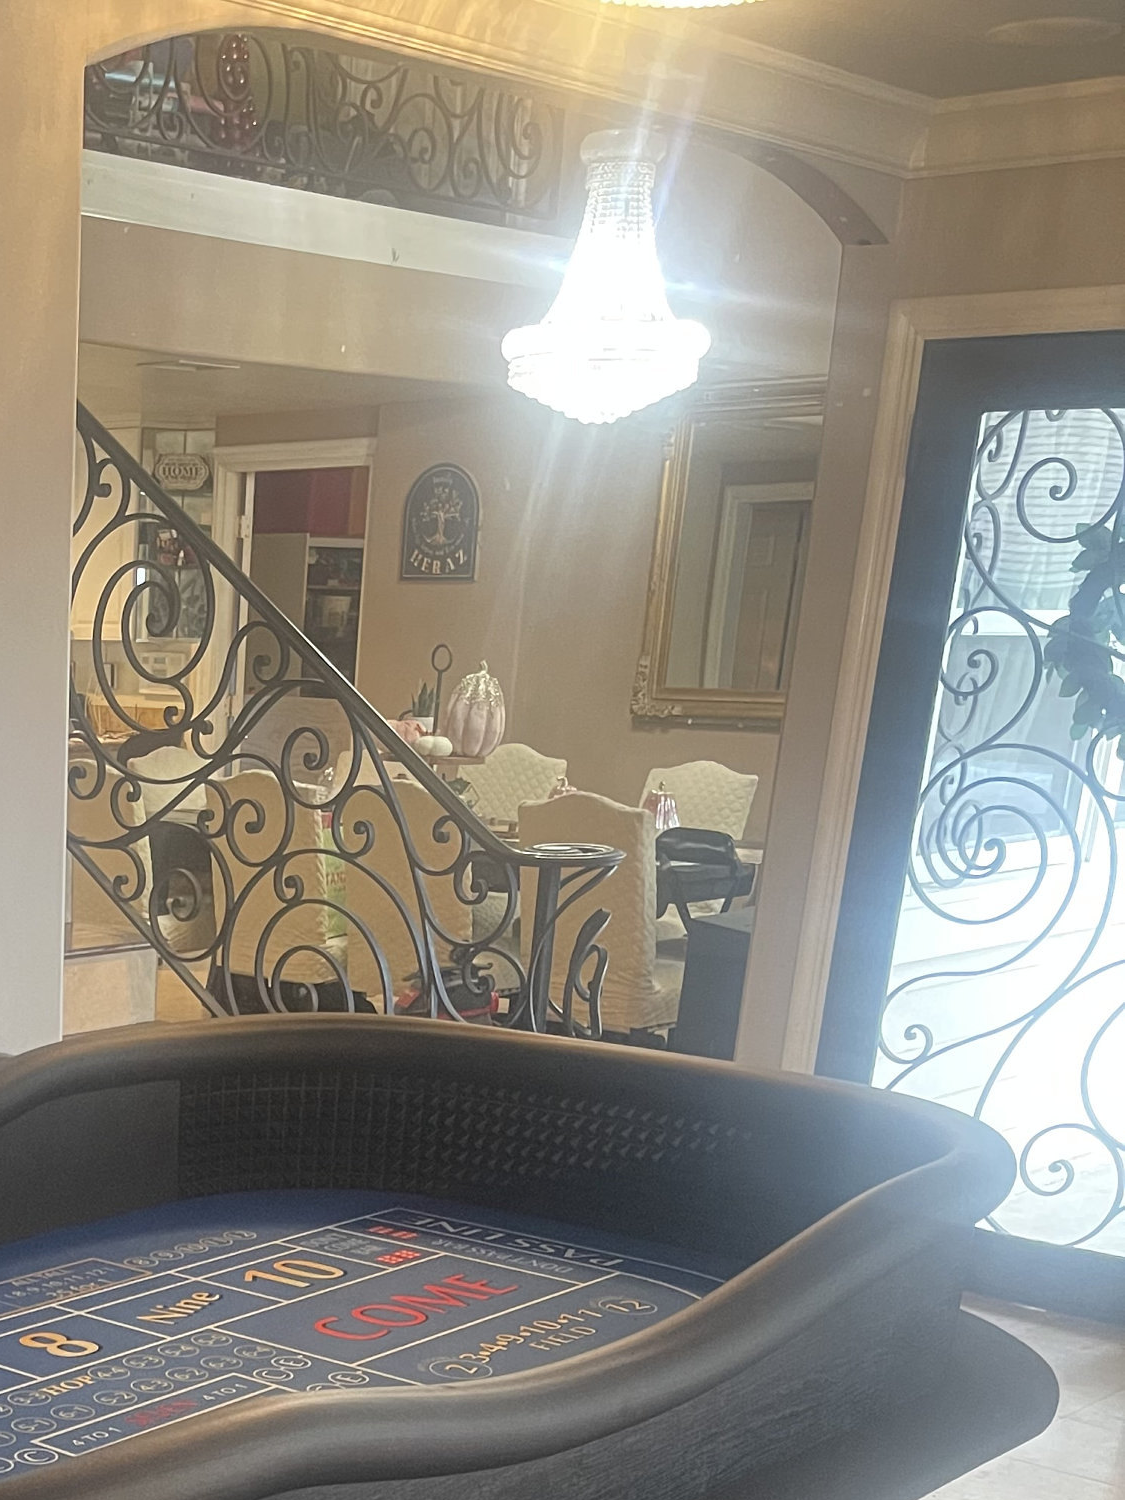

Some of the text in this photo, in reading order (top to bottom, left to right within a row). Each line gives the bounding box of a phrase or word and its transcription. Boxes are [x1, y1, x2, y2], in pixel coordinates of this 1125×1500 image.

[161, 466, 205, 476] HOME
[410, 549, 468, 574] HERAZ
[402, 1216, 625, 1267] PASS LINE
[244, 1258, 345, 1289] 10
[136, 1290, 222, 1326] Nine
[314, 1273, 519, 1341] COME
[18, 1331, 100, 1359] 8
[444, 1362, 479, 1375] 2
[605, 1299, 653, 1313] 12
[528, 1325, 597, 1351] FIELD
[261, 1369, 287, 1381] C
[279, 1357, 305, 1368] E
[42, 1374, 97, 1396] HOP
[335, 1373, 363, 1384] E
[100, 1390, 135, 1404] 5-2
[72, 1438, 85, 1448] 4
[81, 1430, 109, 1443] TO
[211, 1387, 237, 1397] TO
[23, 1450, 51, 1462] C
